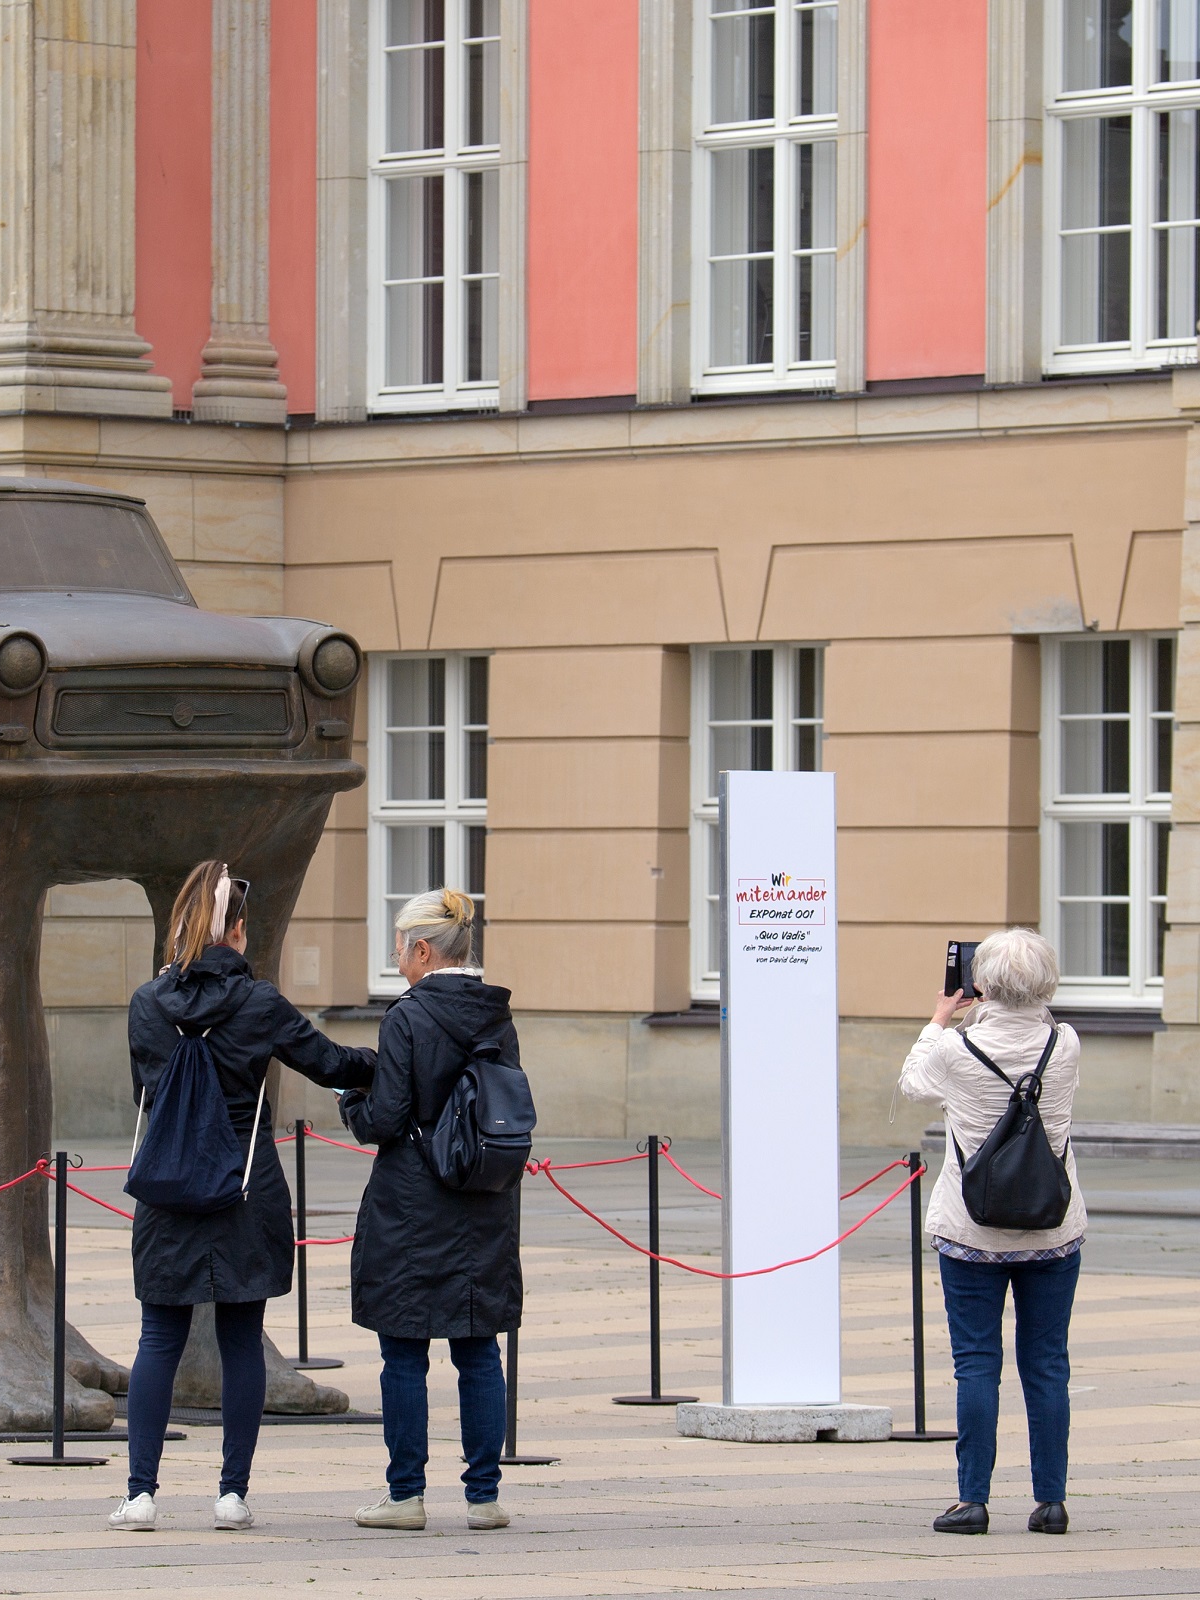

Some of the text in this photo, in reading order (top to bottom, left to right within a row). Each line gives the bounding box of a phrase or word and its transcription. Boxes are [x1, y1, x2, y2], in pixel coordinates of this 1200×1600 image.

[771, 872, 792, 887] Wir
[736, 885, 827, 902] miteinander
[749, 909, 815, 919] EXPOnat 001
[742, 944, 756, 952] (ein
[757, 944, 783, 952] Trabant
